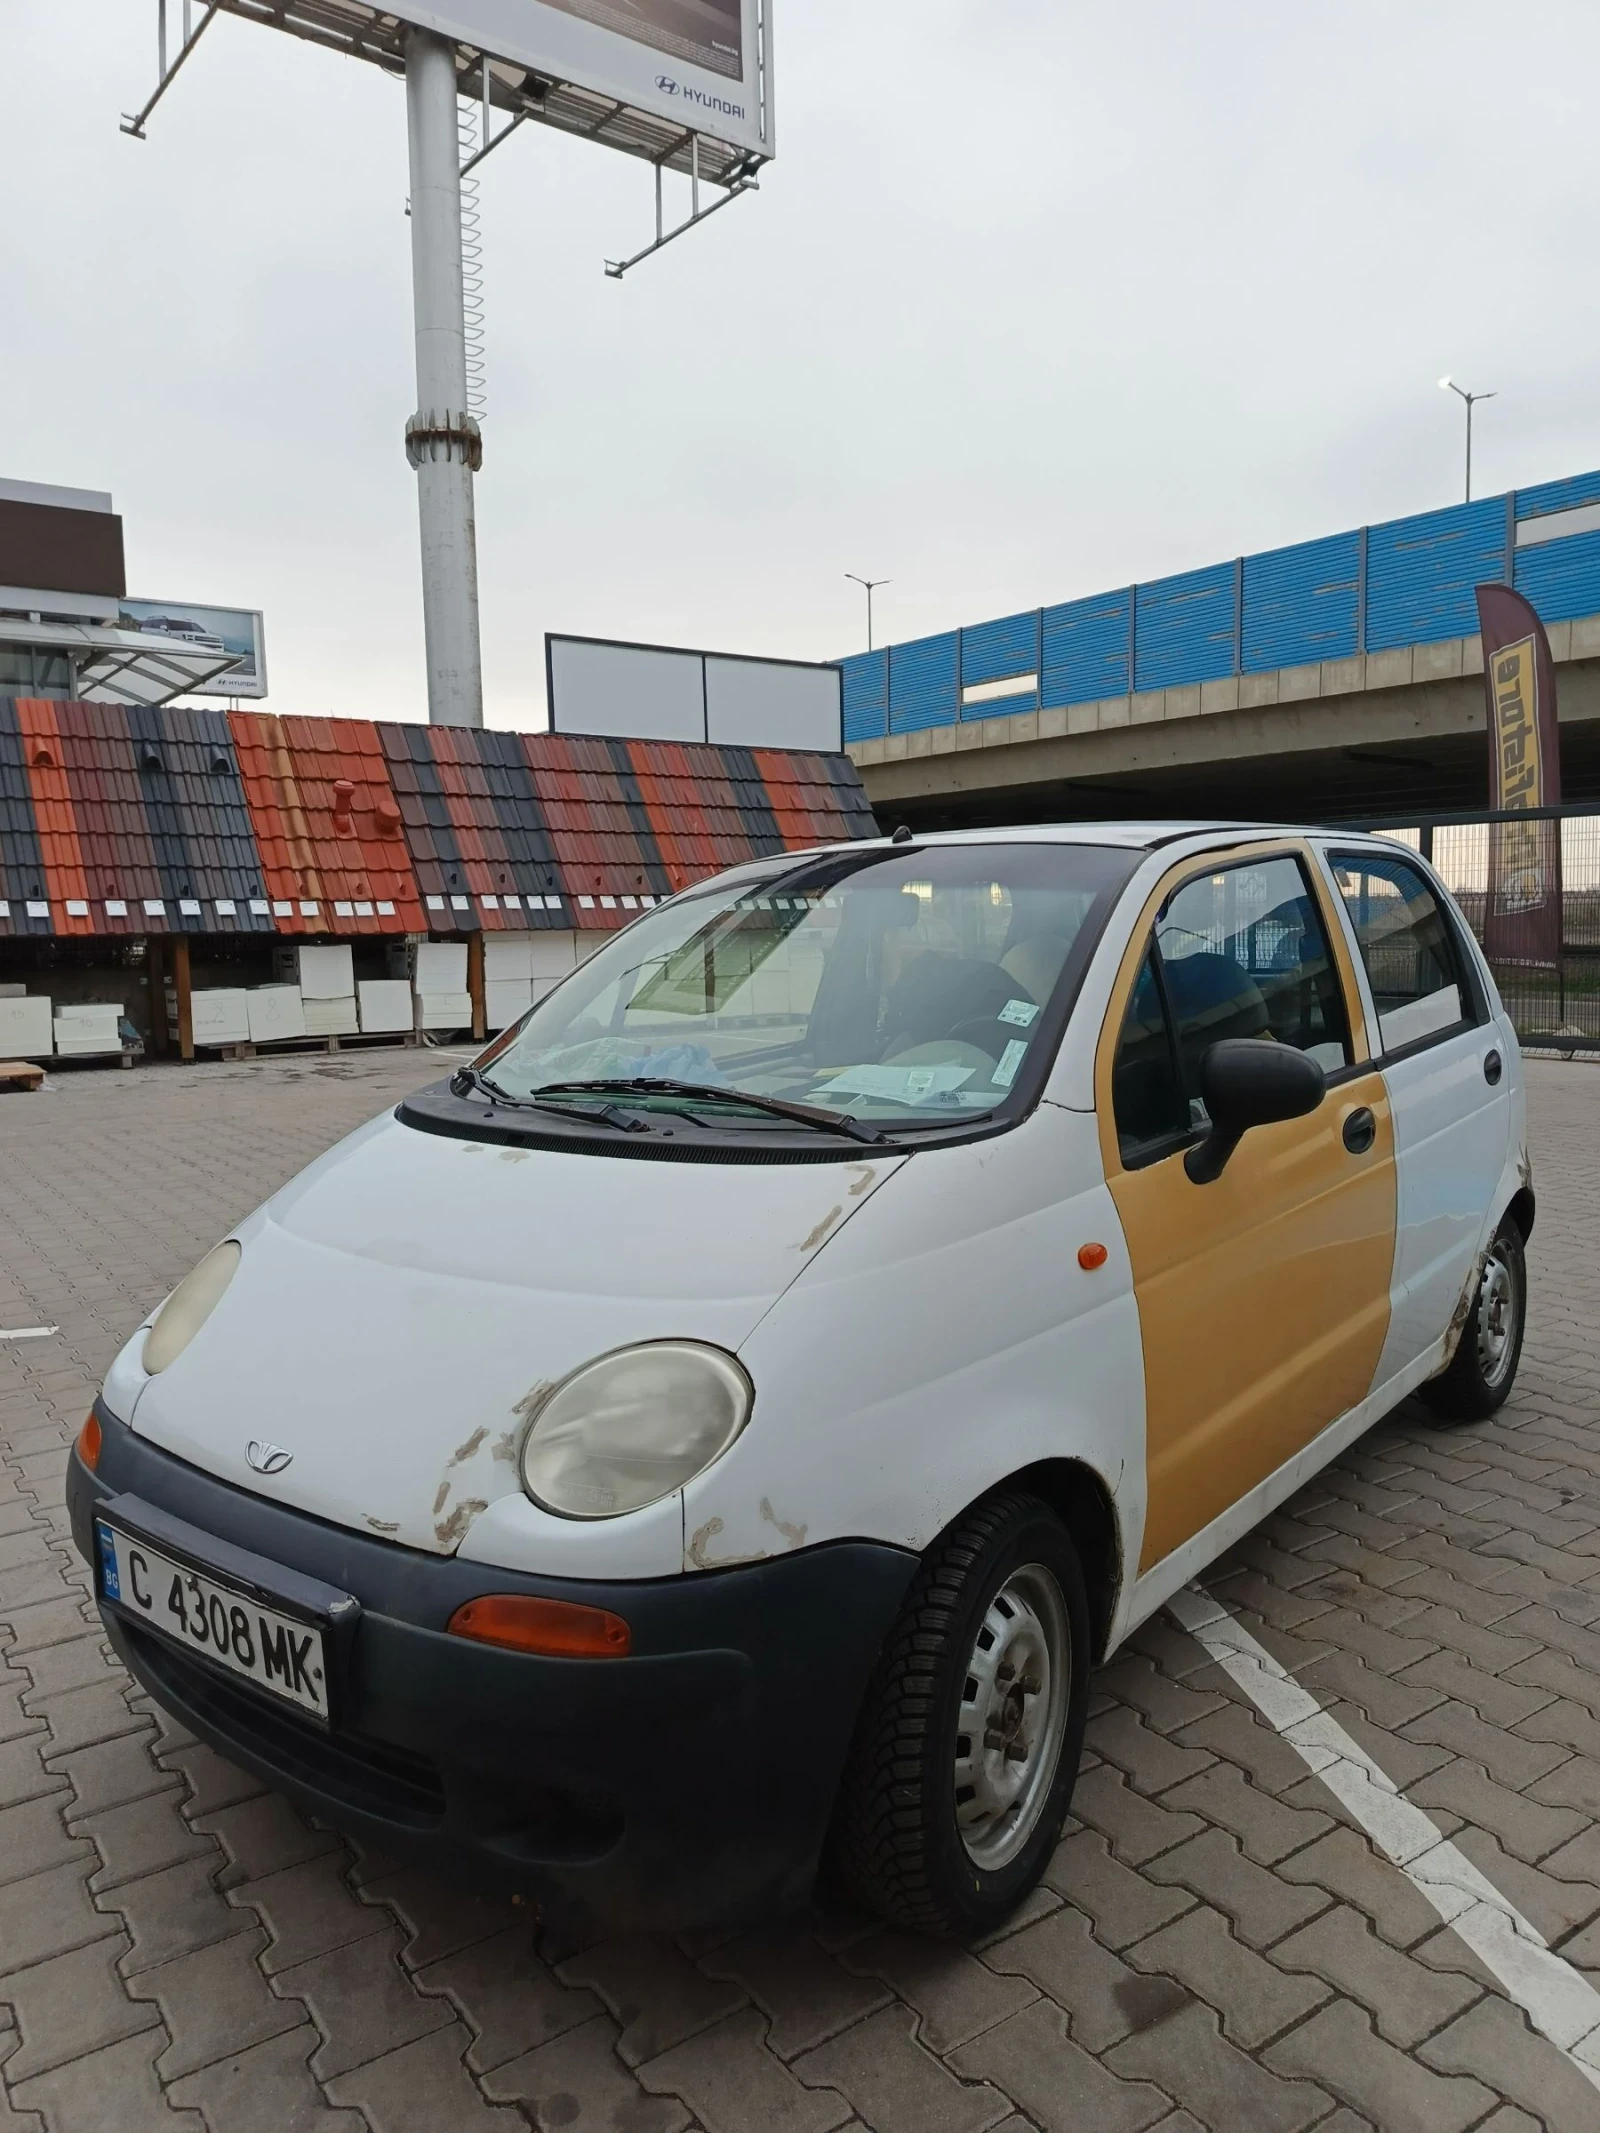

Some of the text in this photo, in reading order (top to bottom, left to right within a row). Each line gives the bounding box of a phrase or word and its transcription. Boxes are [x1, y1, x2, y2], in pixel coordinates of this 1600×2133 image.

[683, 86, 745, 120] HYUNDAI
[105, 1568, 118, 1589] BG
[129, 1549, 320, 1703] C 4308 MK
